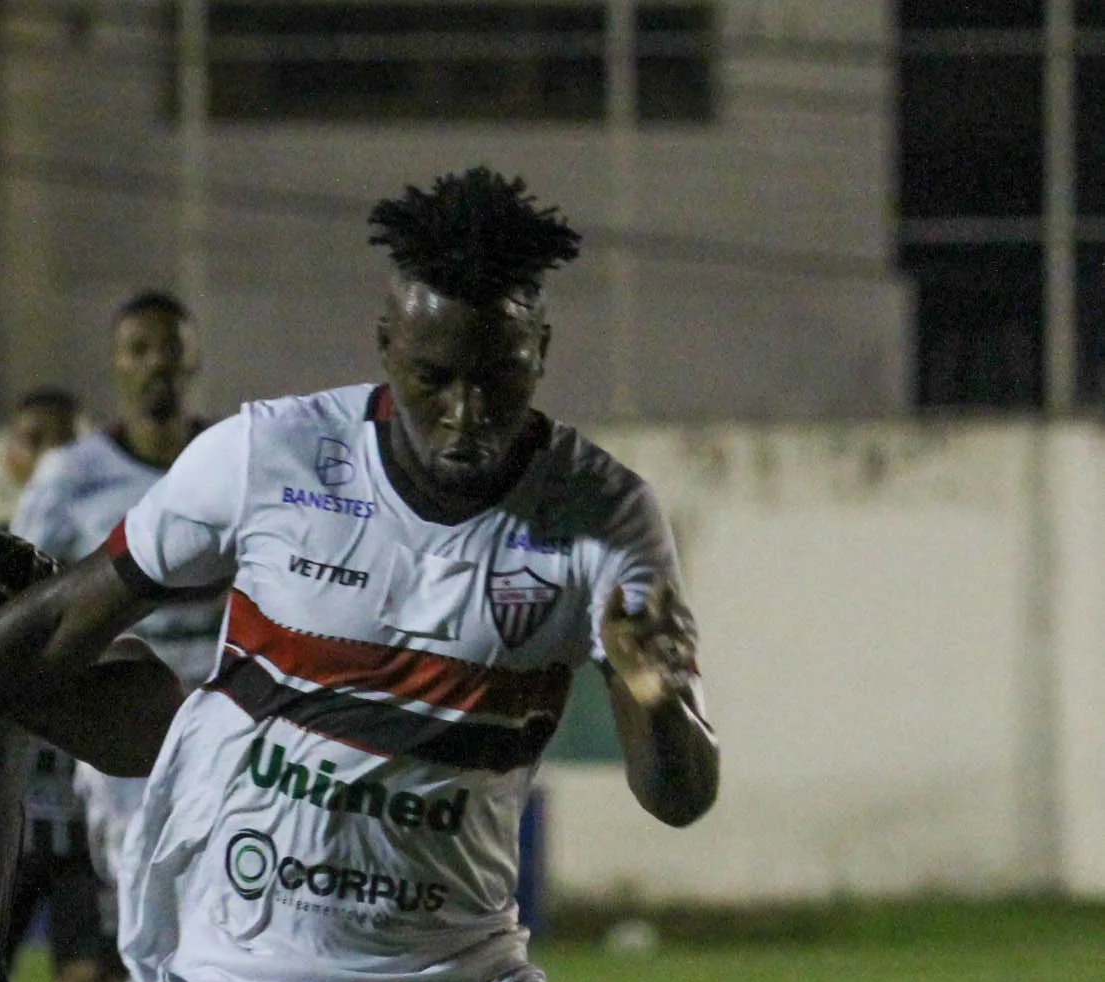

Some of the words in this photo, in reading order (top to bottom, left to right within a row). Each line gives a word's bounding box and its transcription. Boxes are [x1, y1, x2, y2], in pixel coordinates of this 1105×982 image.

[282, 486, 375, 520] BANESTES
[288, 554, 370, 589] VETTOR
[248, 735, 470, 835] Unimed
[276, 855, 451, 913] CORPUS
